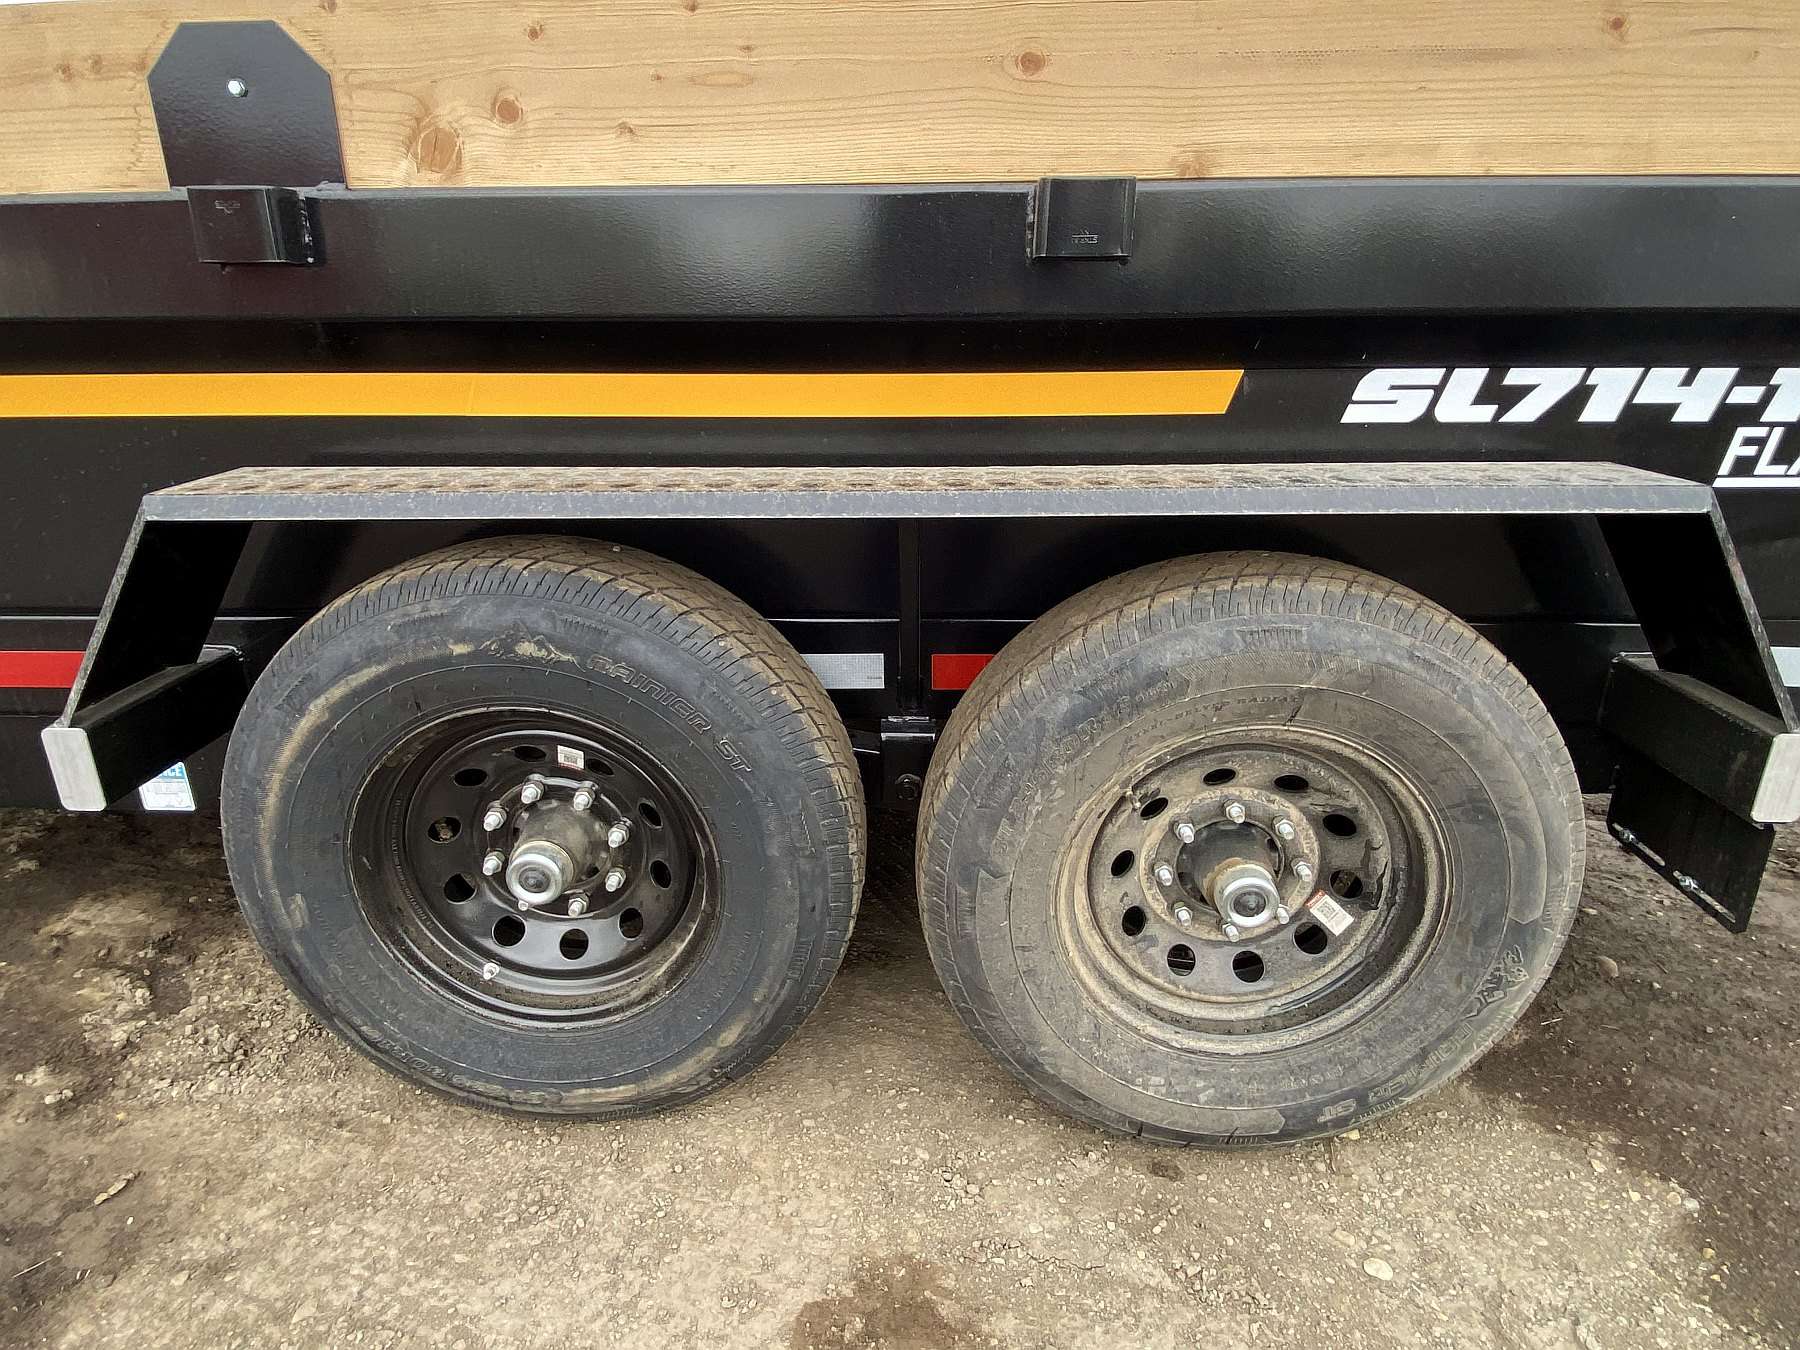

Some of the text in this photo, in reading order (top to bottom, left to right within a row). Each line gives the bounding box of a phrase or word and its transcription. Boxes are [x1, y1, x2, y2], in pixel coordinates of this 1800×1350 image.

[1717, 426, 1800, 475] FL
[586, 653, 752, 773] RAINIER ST
